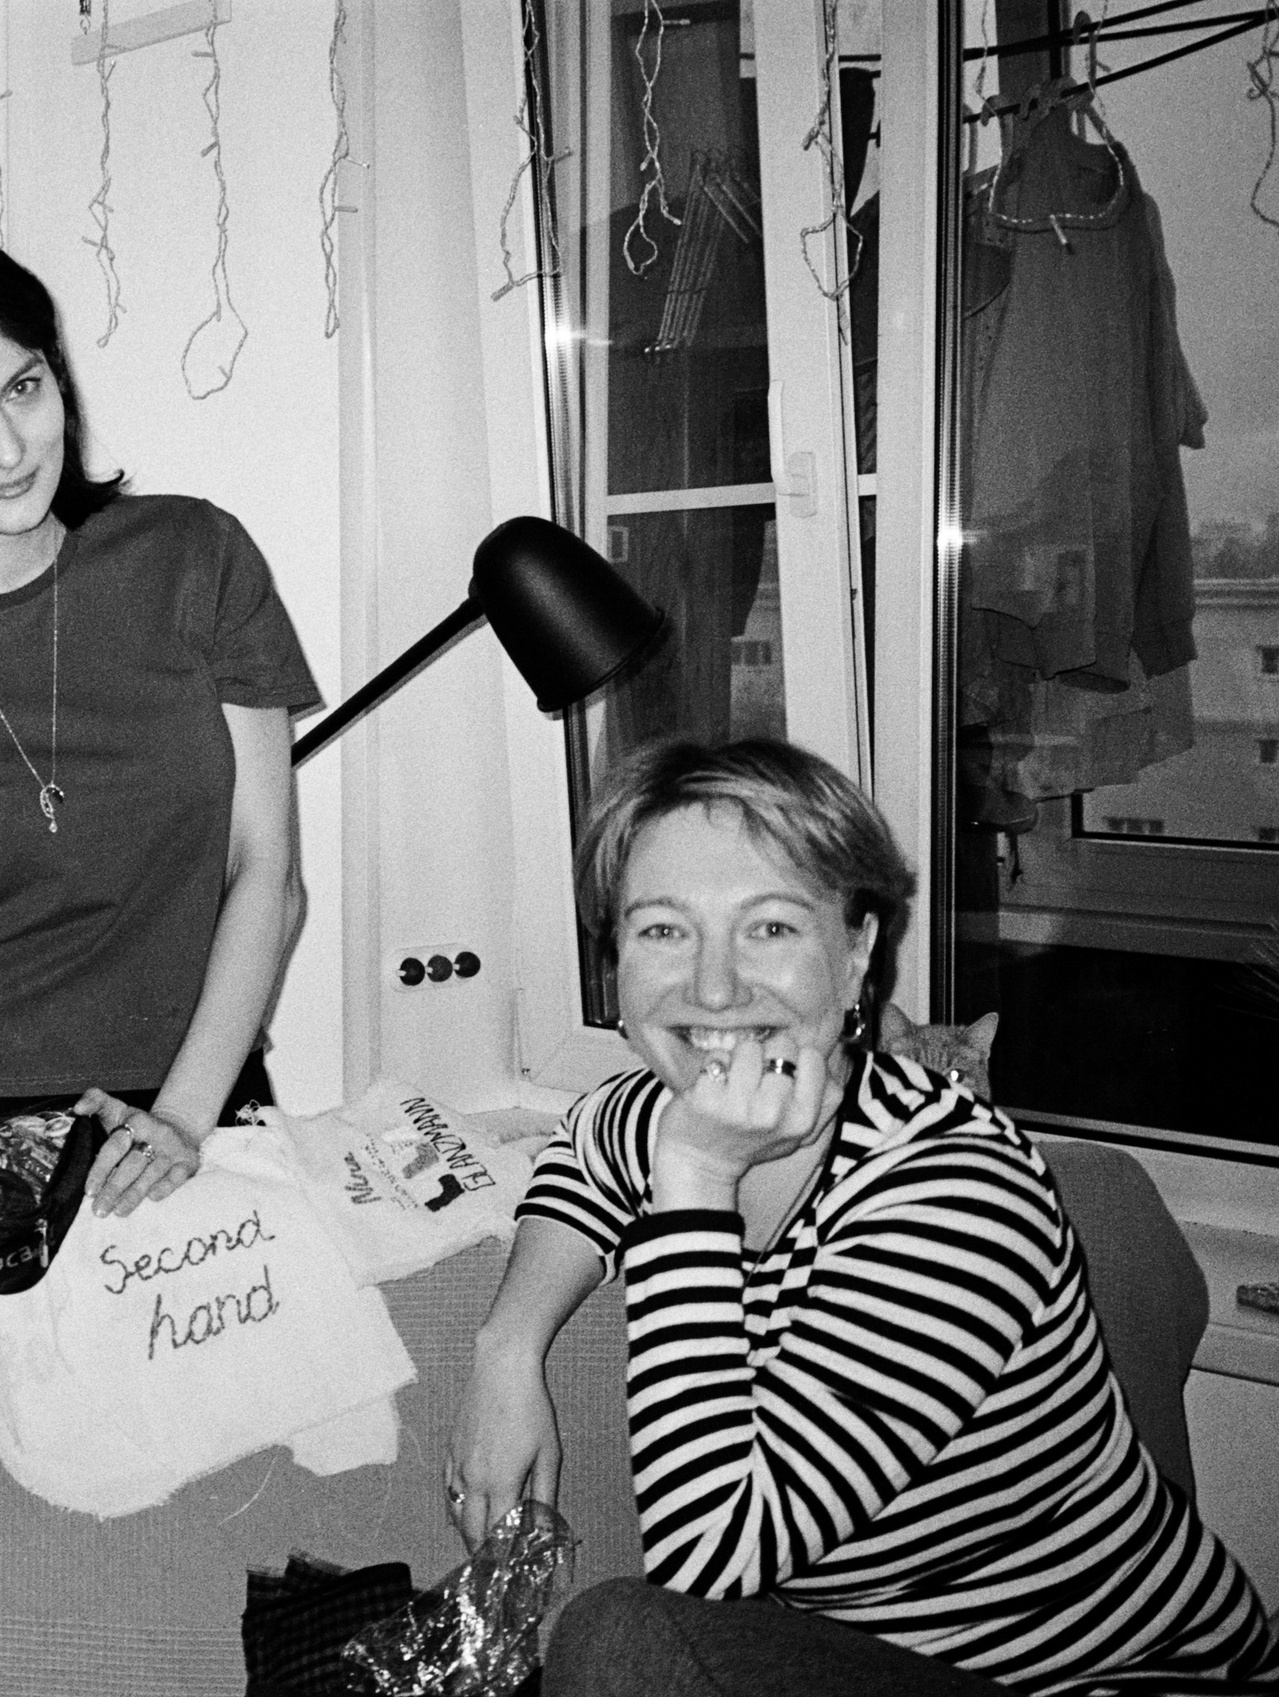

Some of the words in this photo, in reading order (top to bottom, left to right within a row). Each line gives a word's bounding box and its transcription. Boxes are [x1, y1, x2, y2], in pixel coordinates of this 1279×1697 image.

[400, 1097, 496, 1192] GLANZMANN
[100, 1209, 276, 1295] Second
[148, 1264, 280, 1360] hand
